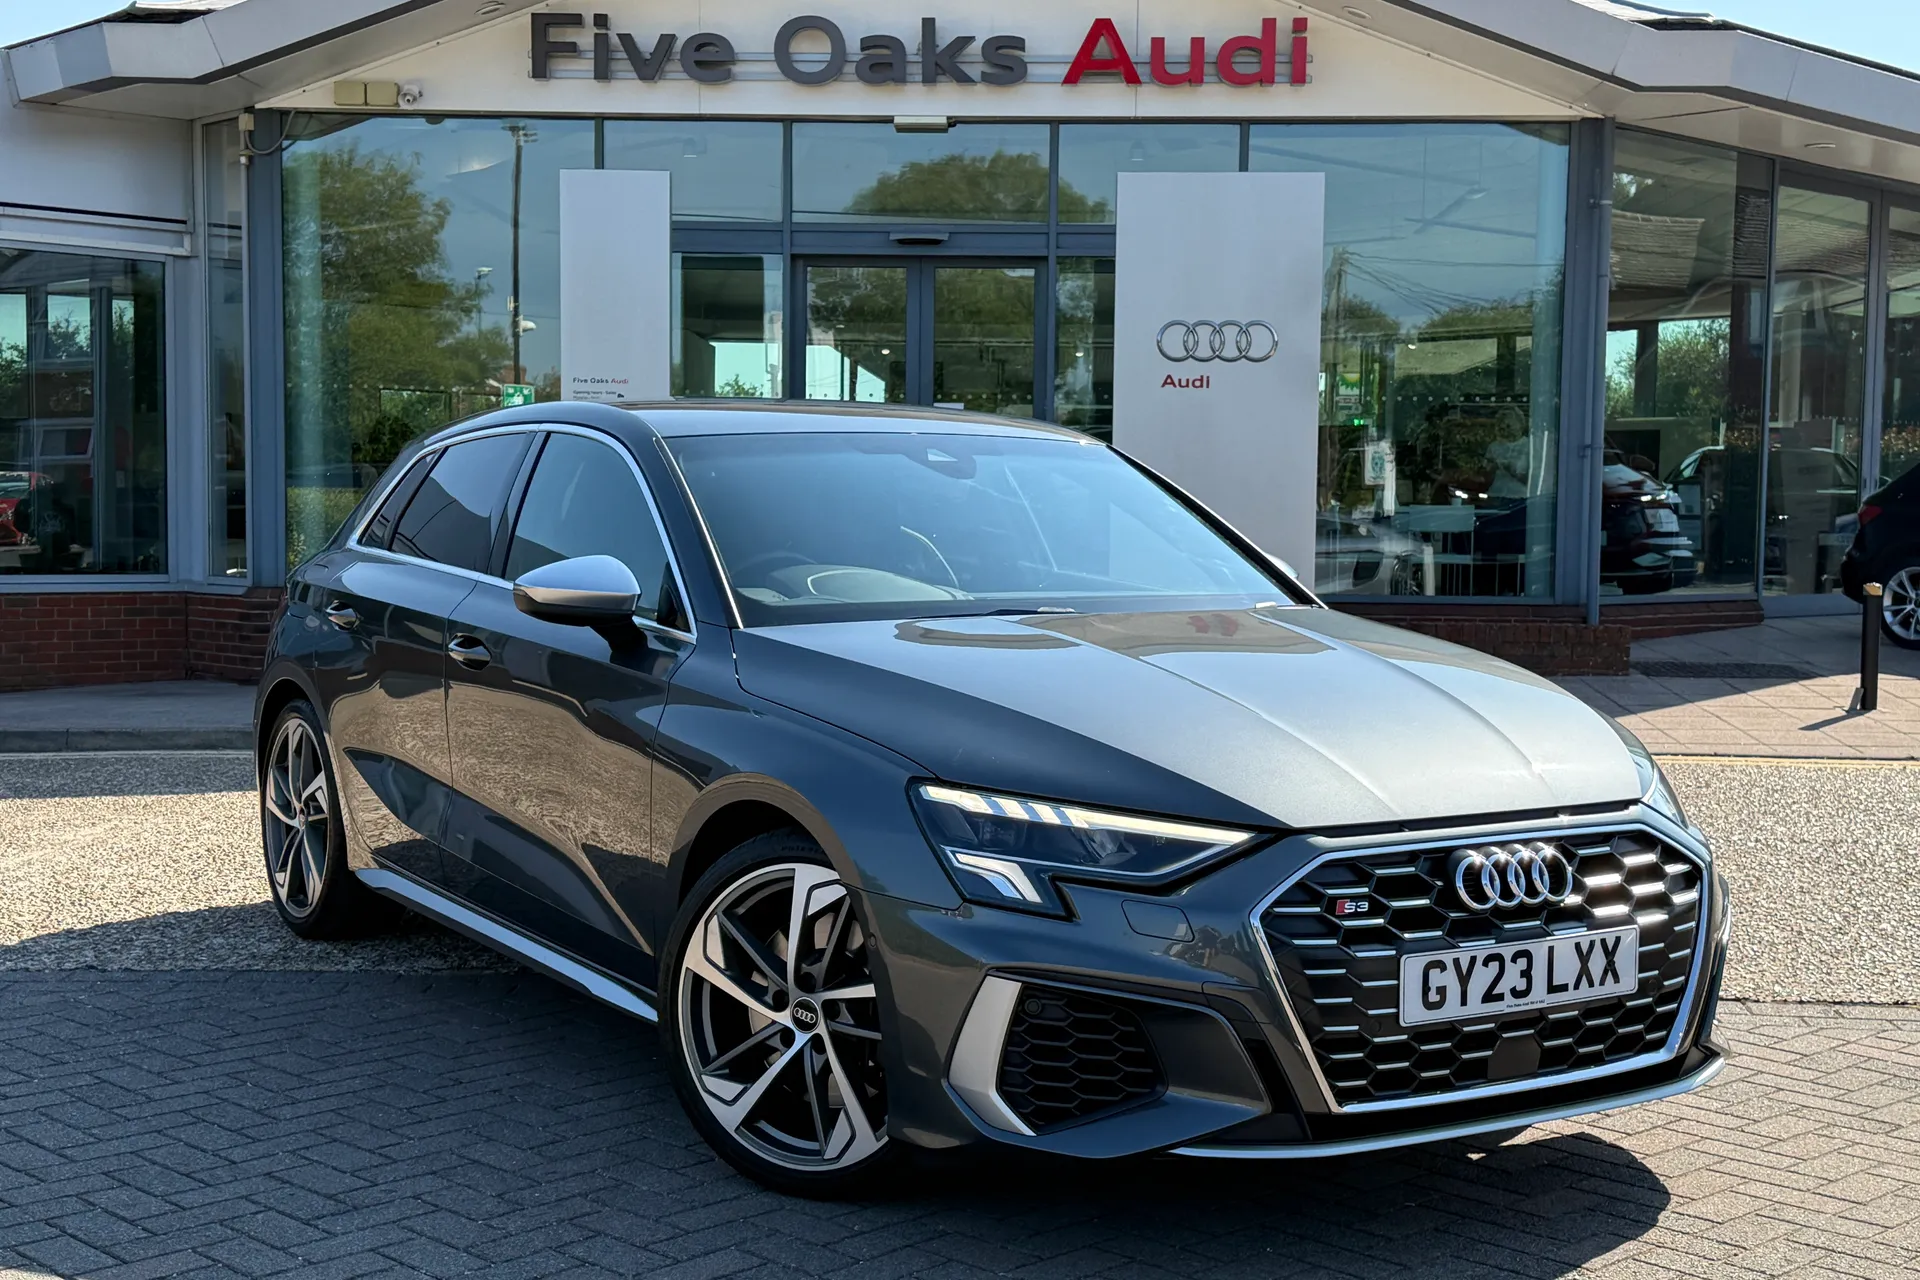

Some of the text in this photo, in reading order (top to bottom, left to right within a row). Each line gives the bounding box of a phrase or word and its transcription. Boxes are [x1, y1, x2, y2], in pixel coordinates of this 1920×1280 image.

[531, 13, 1308, 87] Five Oaks Audi
[1160, 373, 1211, 389] Audi
[1343, 901, 1369, 913] S3
[1422, 935, 1622, 1011] GY23 LXX
